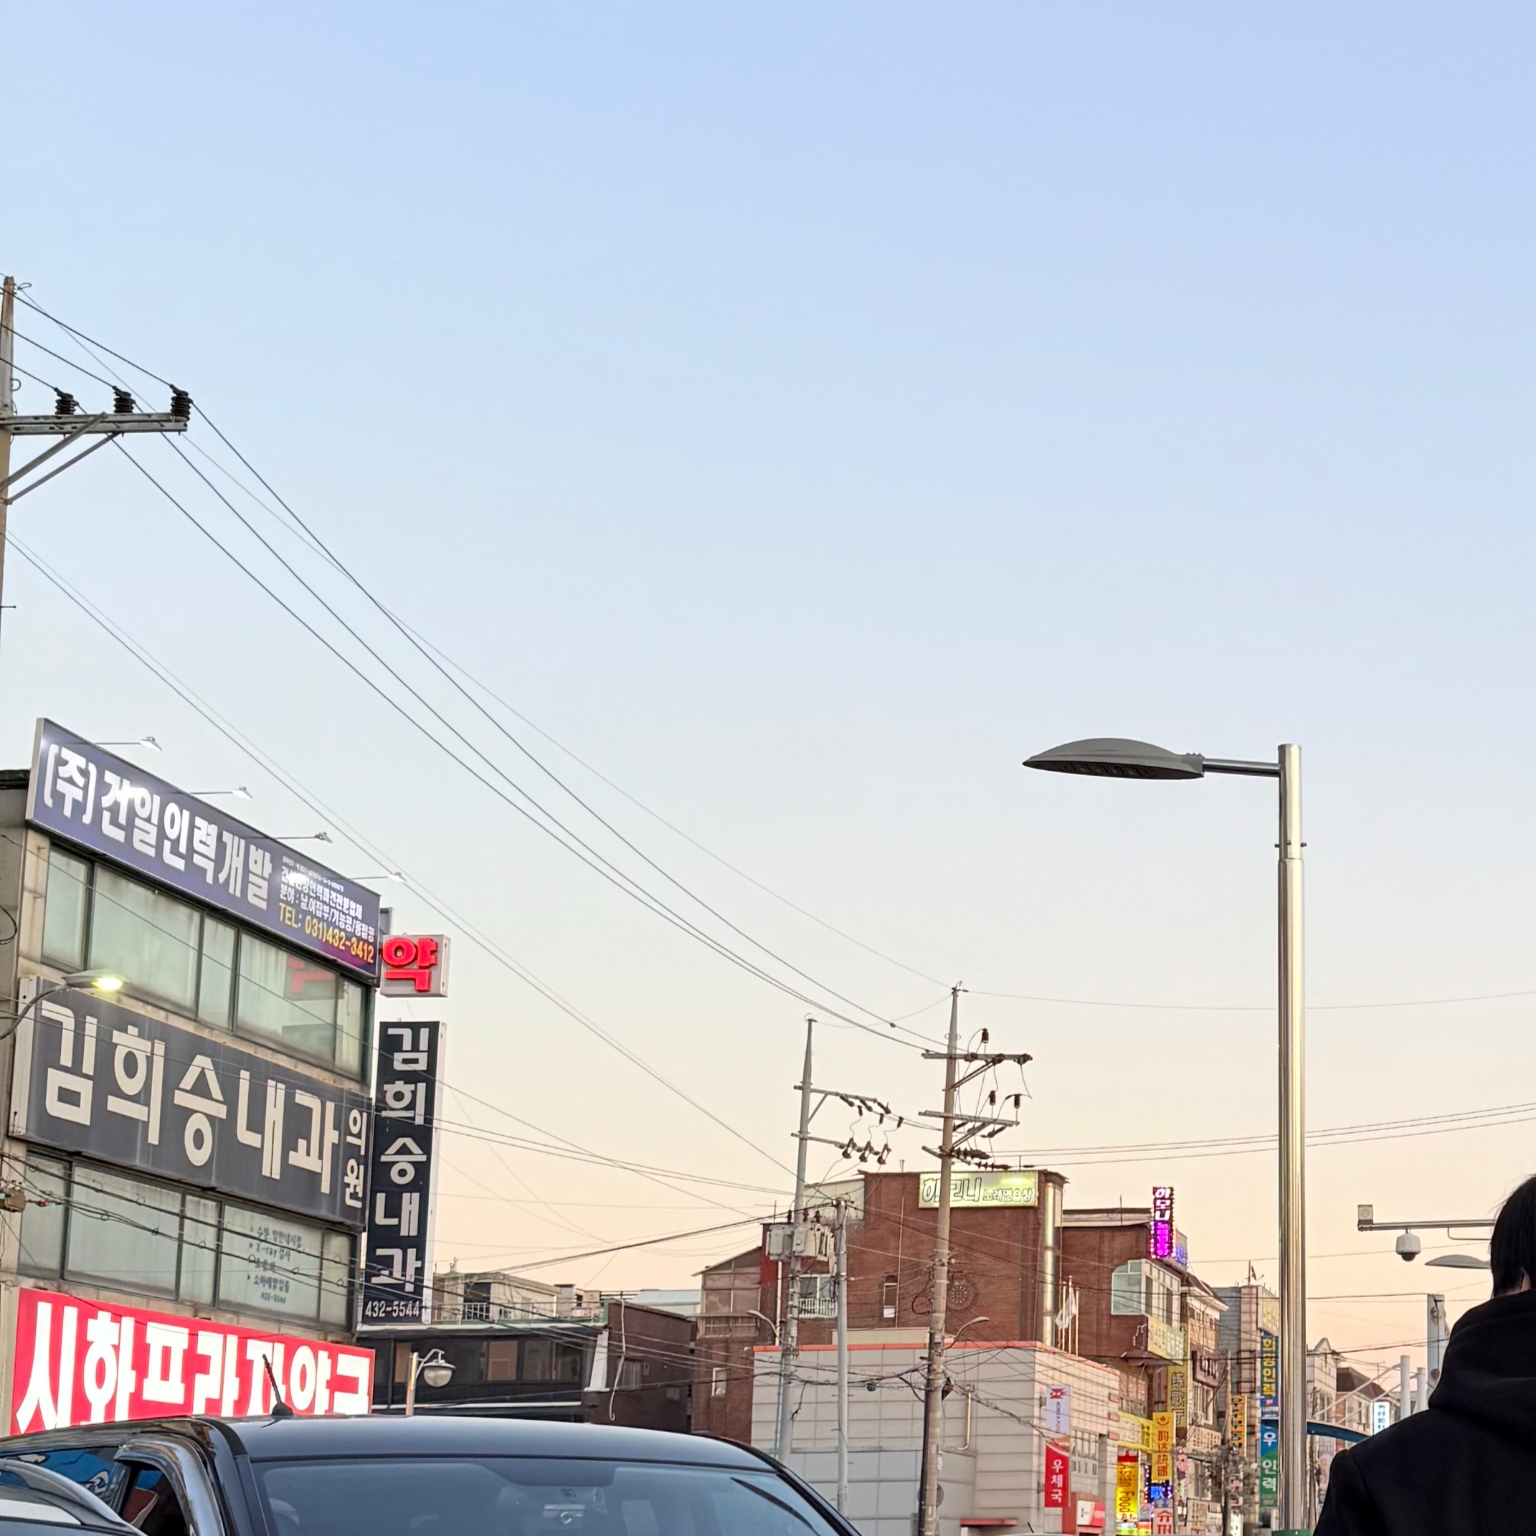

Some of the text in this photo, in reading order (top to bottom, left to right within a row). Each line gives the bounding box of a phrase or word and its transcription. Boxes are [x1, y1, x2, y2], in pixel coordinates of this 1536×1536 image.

[305, 915, 374, 963] 031)432-3412
[381, 937, 438, 993] 약
[41, 999, 368, 1209] 김희승내과 의원
[371, 1027, 428, 1293] 김희승내과
[365, 1300, 421, 1318] 432-5544
[1051, 1459, 1063, 1503] 우체국
[1119, 1490, 1135, 1513] Food
